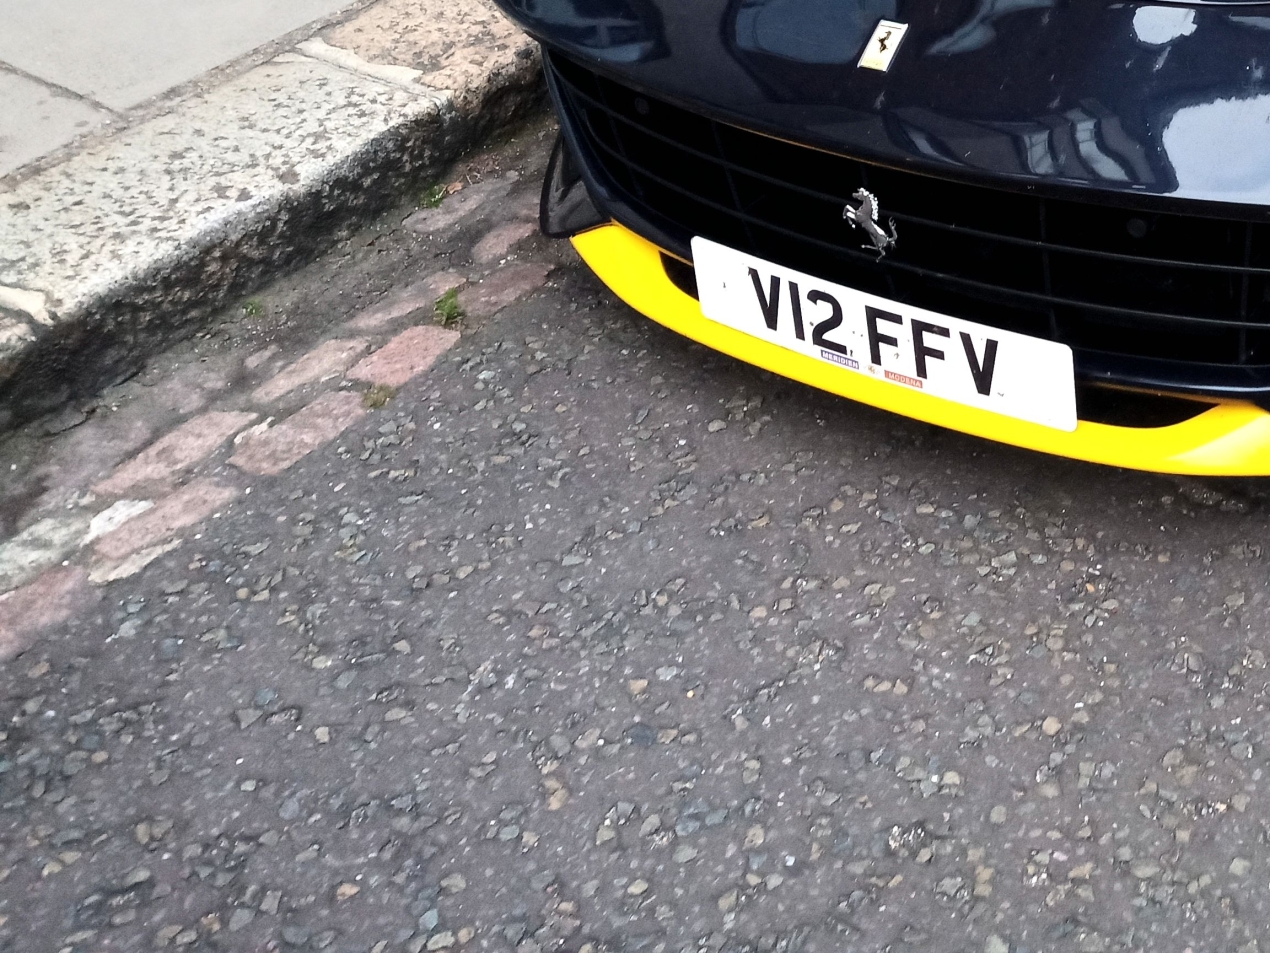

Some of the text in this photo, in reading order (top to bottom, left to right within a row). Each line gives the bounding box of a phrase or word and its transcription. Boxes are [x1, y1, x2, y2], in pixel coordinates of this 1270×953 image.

[748, 266, 999, 397] V12 FFV
[821, 351, 921, 388] MERIDIEN MODENA
